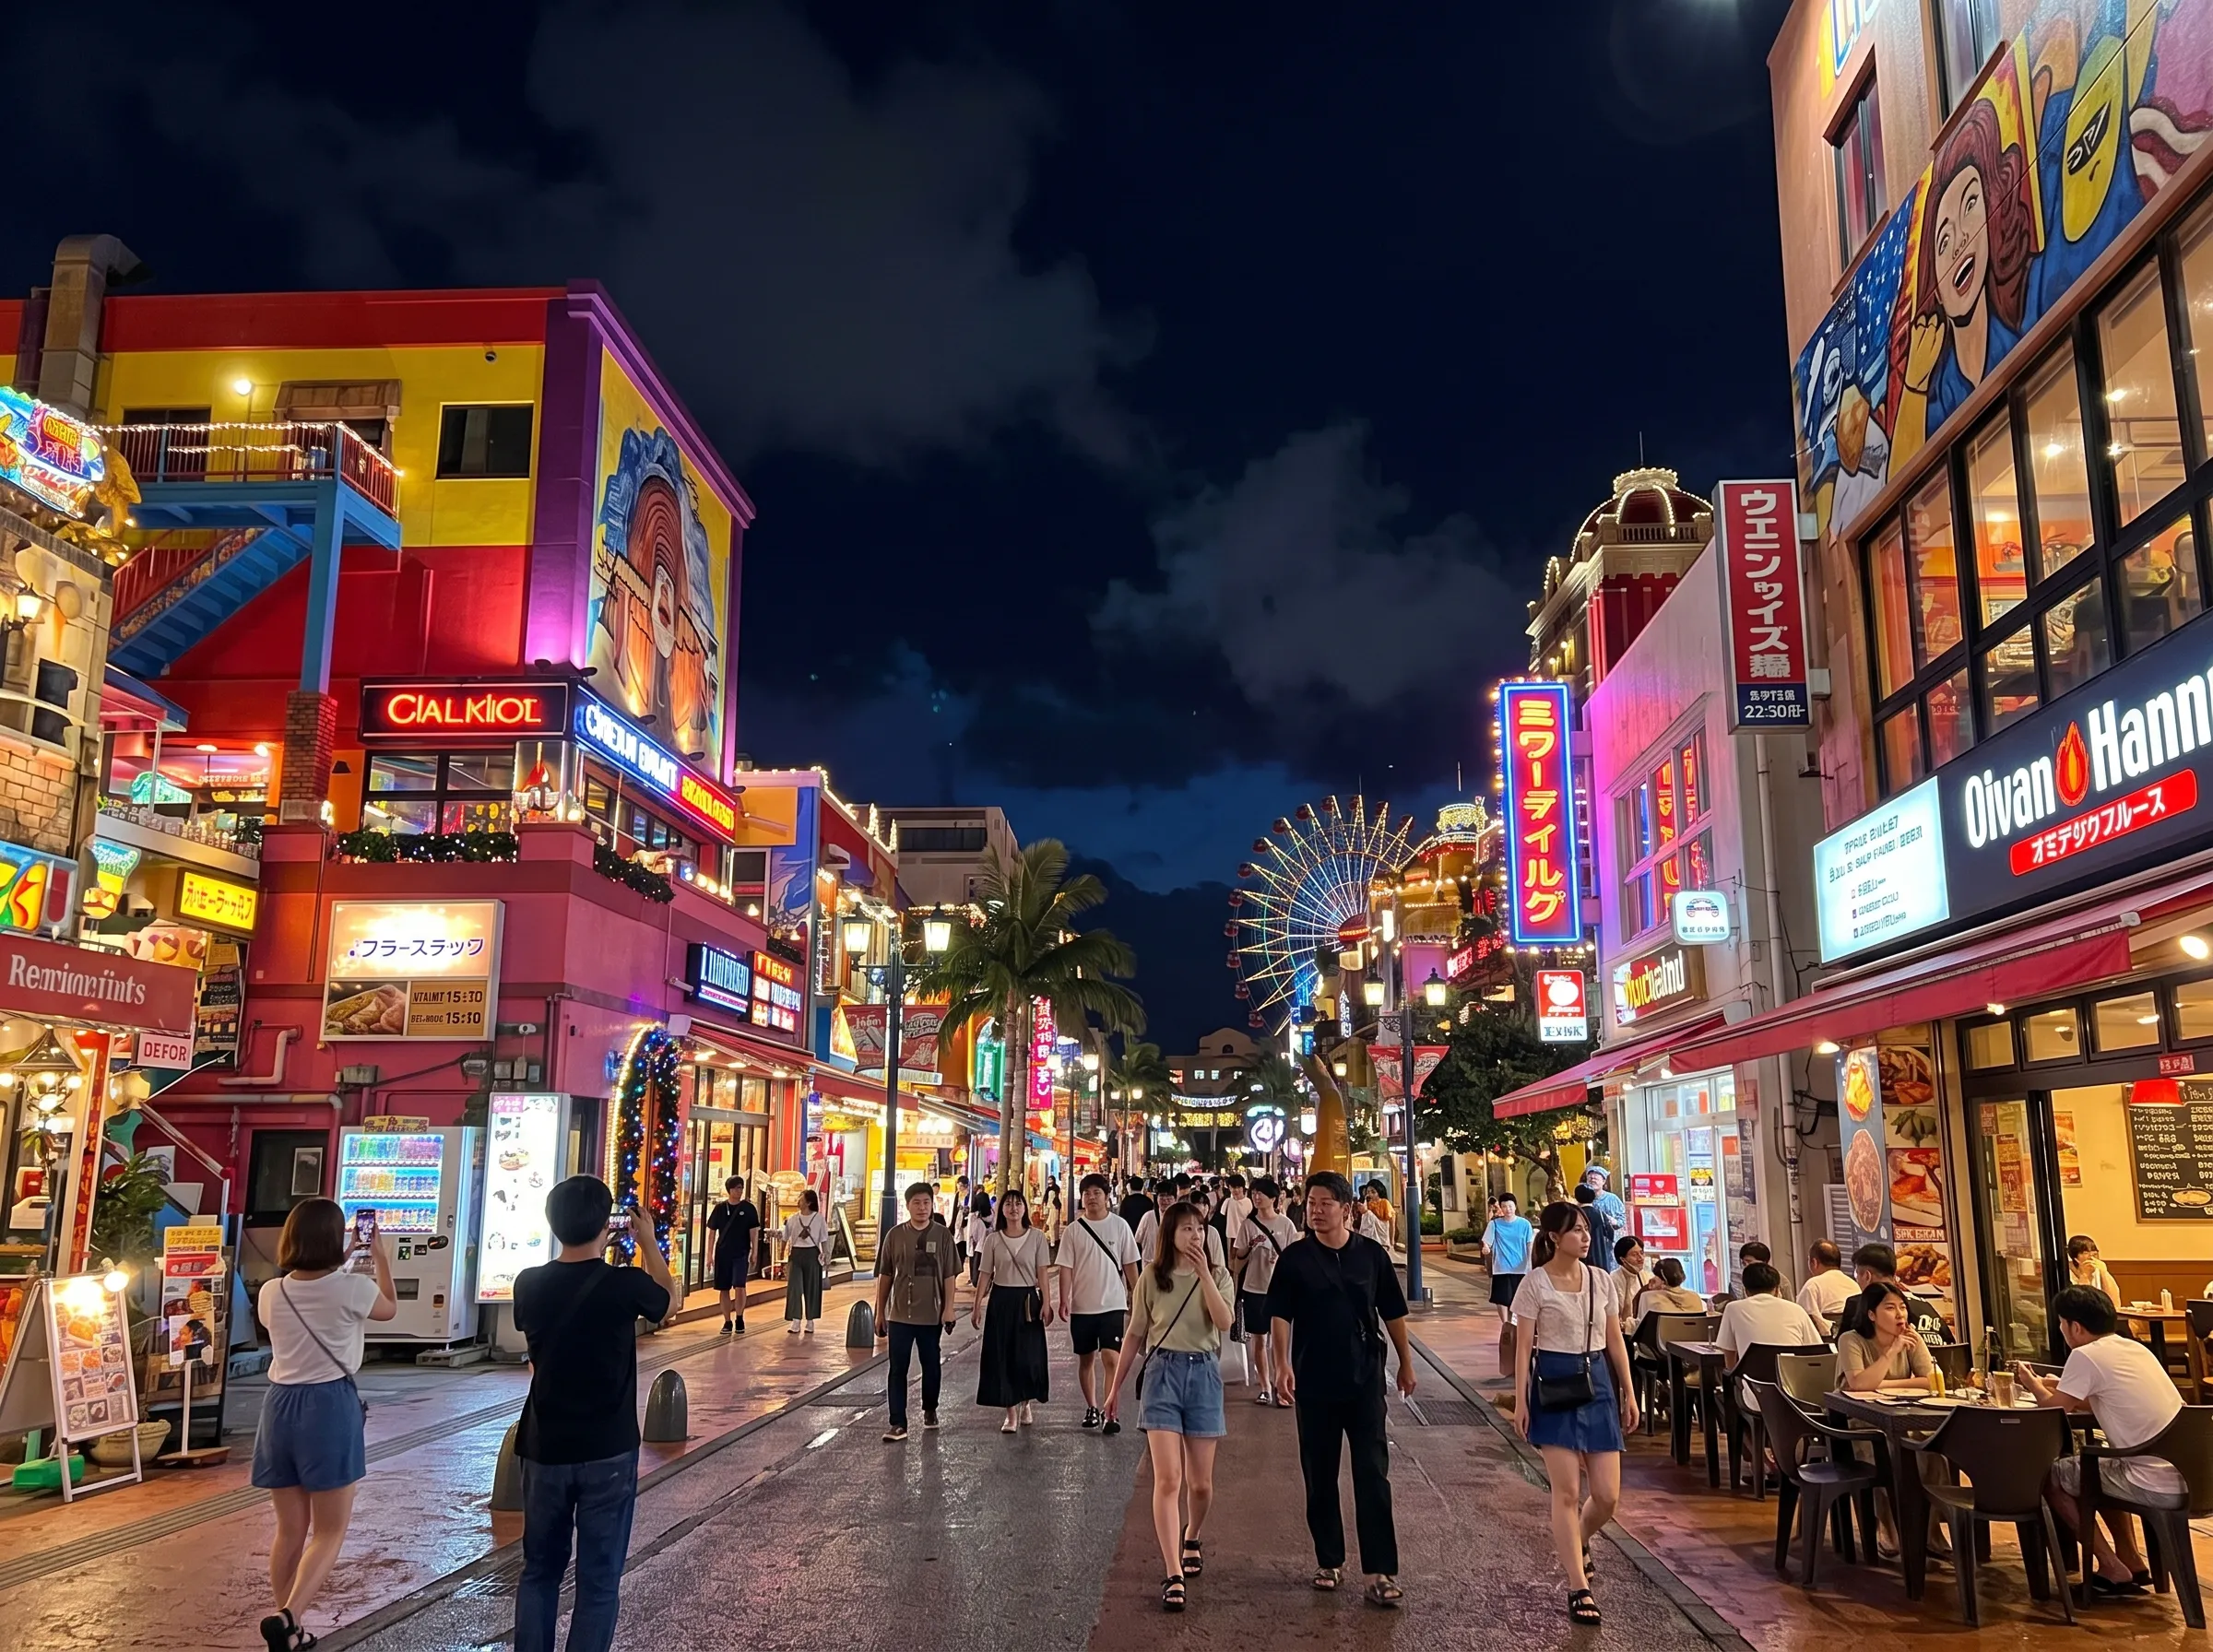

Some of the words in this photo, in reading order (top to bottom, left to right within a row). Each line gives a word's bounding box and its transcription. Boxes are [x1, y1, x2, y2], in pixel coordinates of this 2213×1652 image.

[1965, 756, 2056, 849] Oivan
[2089, 667, 2213, 792] Hann
[144, 1042, 187, 1062] DEFOR
